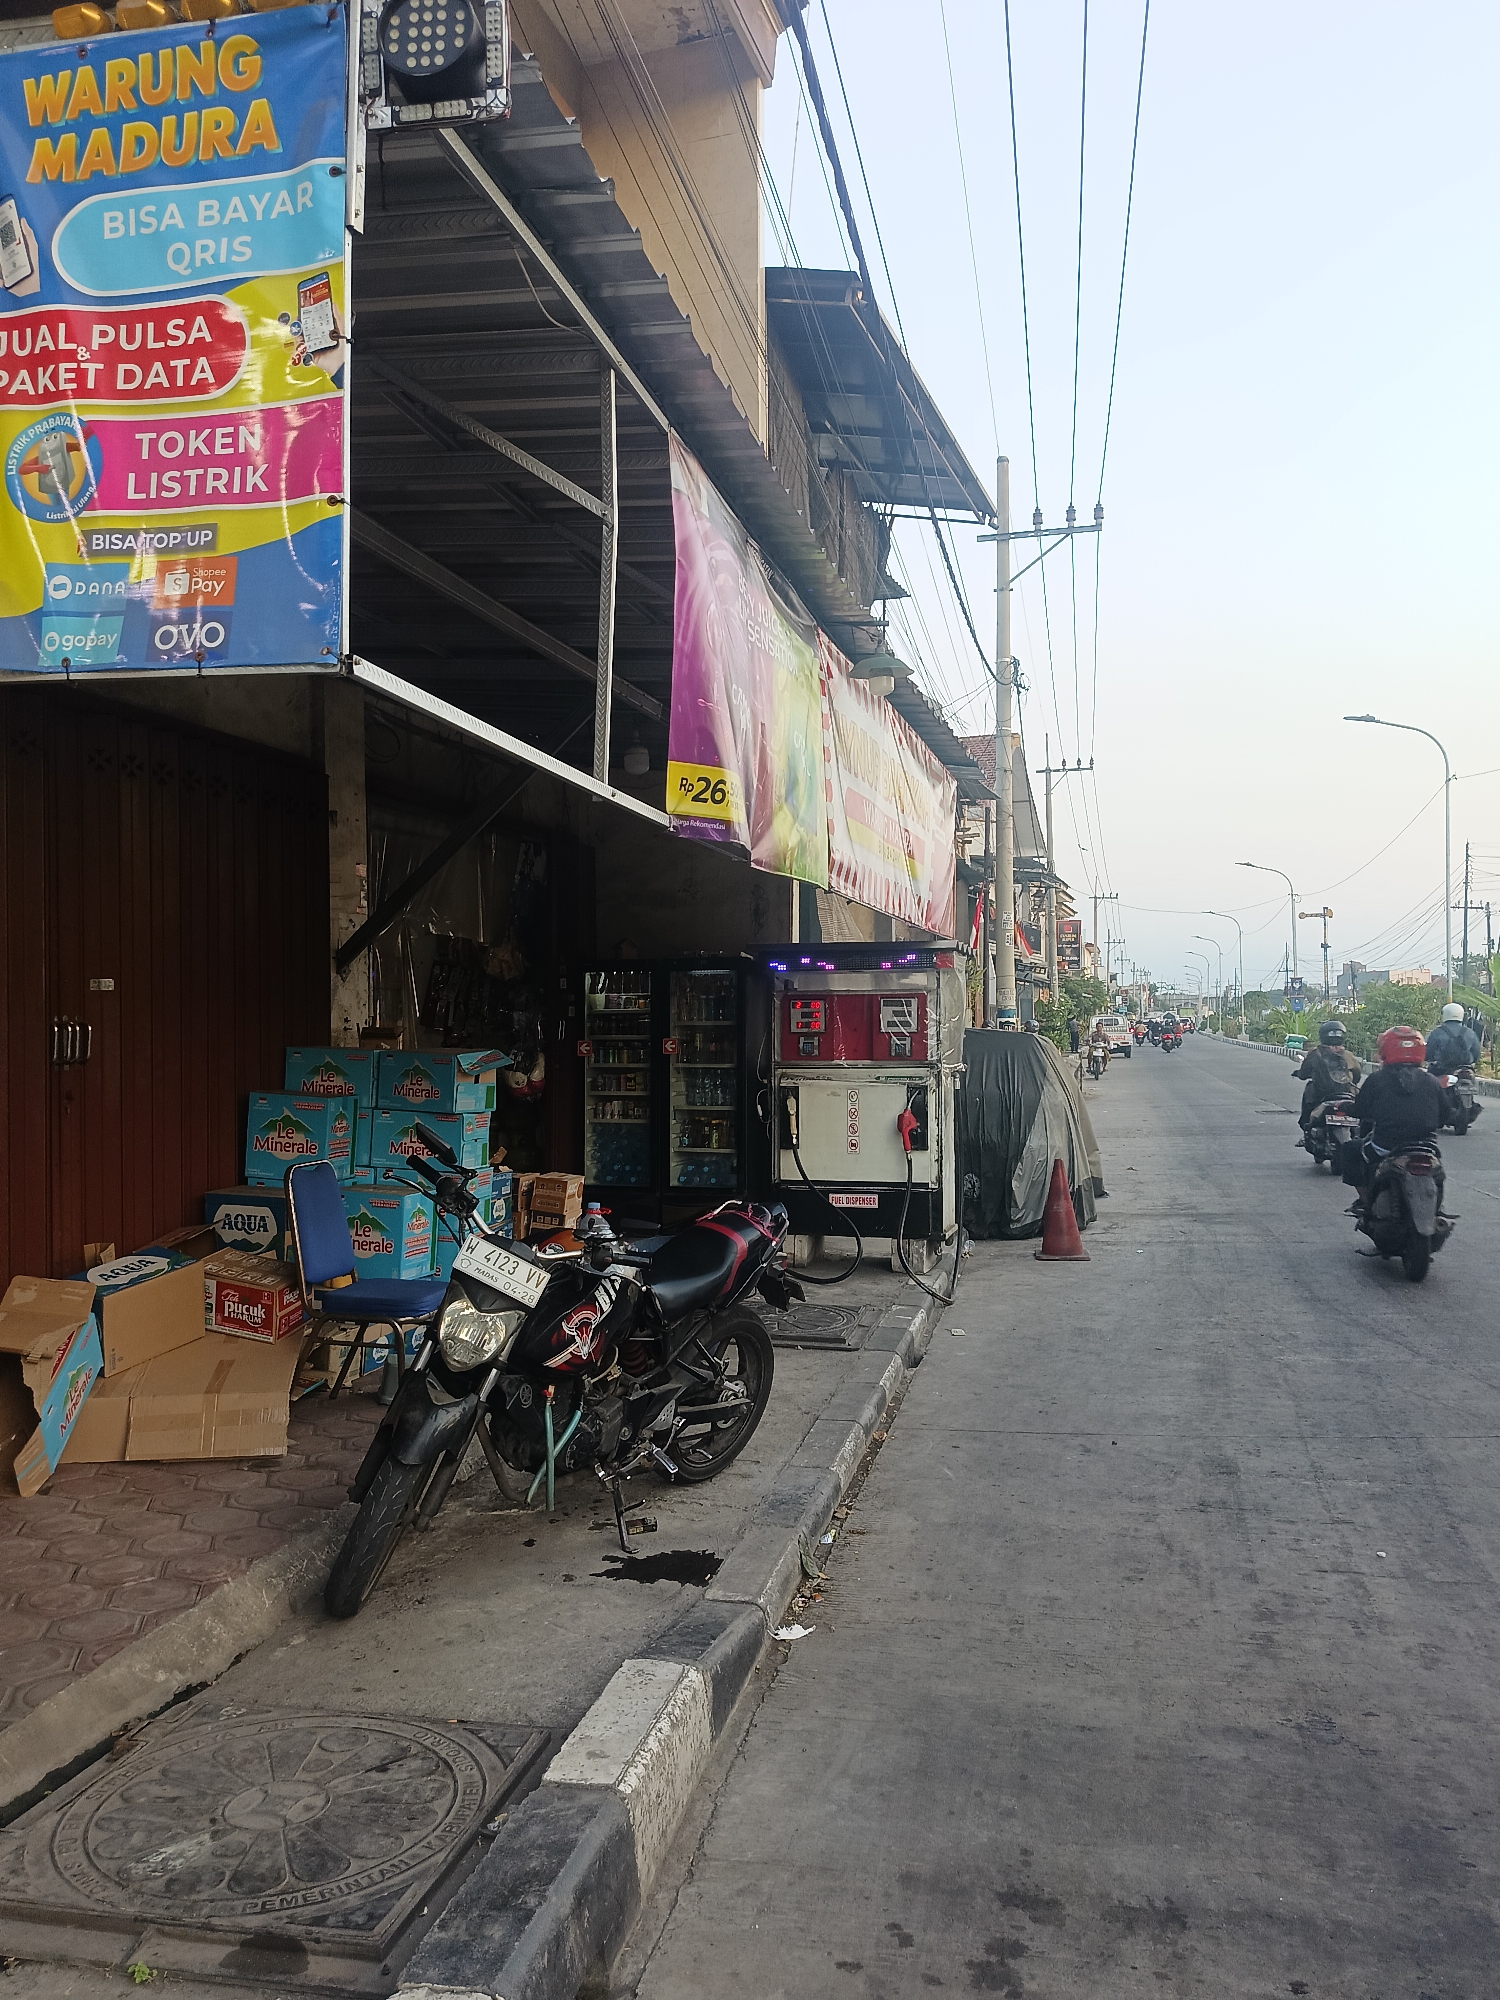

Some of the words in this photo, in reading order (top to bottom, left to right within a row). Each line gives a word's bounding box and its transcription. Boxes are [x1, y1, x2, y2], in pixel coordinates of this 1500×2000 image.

[23, 34, 263, 128] WARUNG
[25, 98, 282, 184] MADURA
[103, 203, 185, 240] BISA
[197, 181, 314, 228] BAYAR
[166, 236, 252, 275] QRIS
[91, 315, 213, 350] PULSA
[76, 346, 91, 361] &
[116, 356, 215, 390] DATA
[135, 424, 262, 460] TOKEN
[7, 436, 30, 475] LISTRIK
[127, 465, 269, 500] LISTRIK
[92, 533, 138, 550] BISA
[143, 531, 181, 549] TOP
[186, 530, 213, 547] UP
[193, 567, 227, 577] Shopee
[74, 581, 126, 596] DANA
[191, 577, 226, 597] Pay
[62, 633, 118, 650] gopay
[155, 621, 225, 650] OVO
[690, 819, 726, 830] Rekomendasi
[320, 1068, 335, 1082] Le
[409, 1071, 423, 1086] Le
[301, 1079, 355, 1095] Minerale
[392, 1083, 440, 1099] Minerale
[276, 1122, 295, 1139] Le
[253, 1136, 318, 1155] Minerale
[831, 1196, 845, 1205] FUEL
[846, 1196, 877, 1206] DISPENSER
[221, 1213, 270, 1235] AQUA
[355, 1220, 372, 1238] Le
[406, 1219, 430, 1232] Minerale
[97, 1258, 158, 1281] AQUA
[465, 1237, 480, 1255] W
[484, 1249, 520, 1276] 4123
[525, 1268, 546, 1289] VV
[474, 1267, 499, 1283] MADAS
[230, 1311, 262, 1324] HARUM
[68, 1380, 80, 1401] Le
[59, 1365, 93, 1438] Minerale
[241, 1857, 413, 1914] PEMERINTAH
